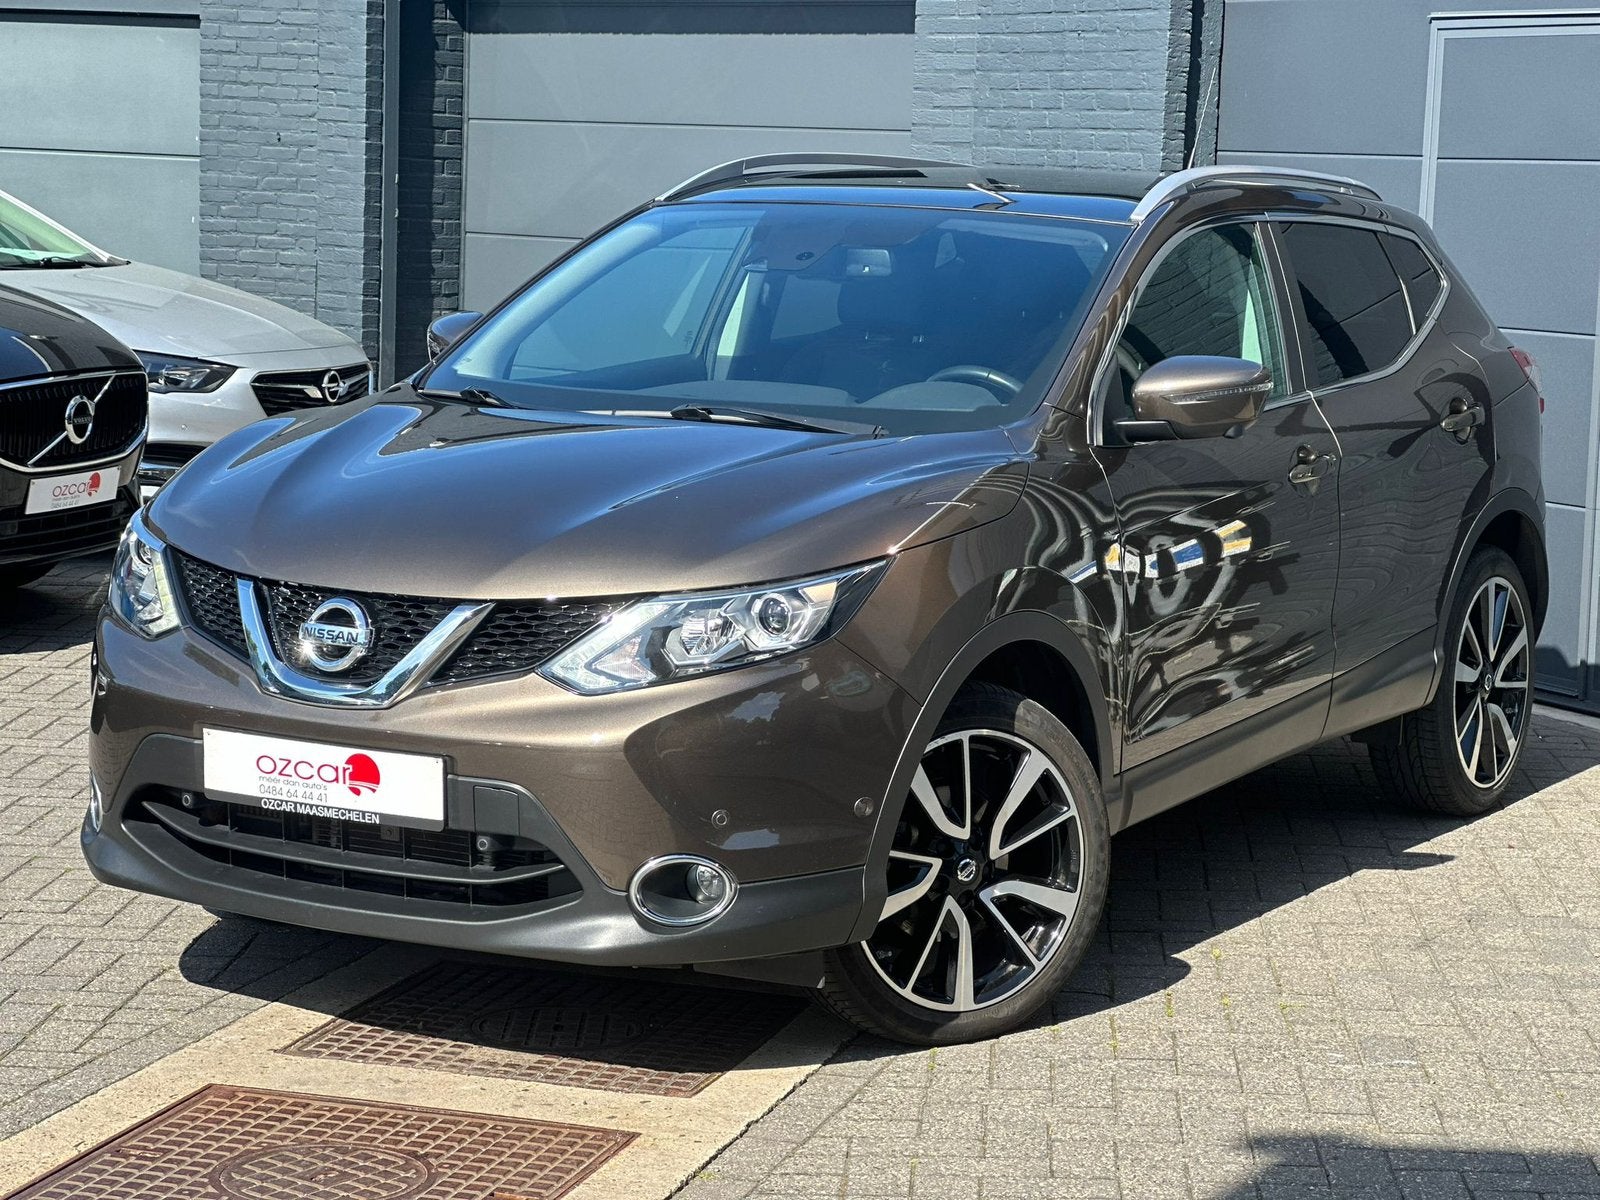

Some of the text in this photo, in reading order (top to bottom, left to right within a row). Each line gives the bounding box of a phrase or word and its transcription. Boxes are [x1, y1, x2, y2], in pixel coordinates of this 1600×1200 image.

[304, 626, 359, 643] NISSAN
[256, 755, 351, 785] ozcar
[259, 783, 328, 803] 0484 64 44 41
[282, 778, 300, 787] dan
[301, 782, 328, 791] auto's
[261, 798, 380, 825] OZCAR MAASMECHELEN
